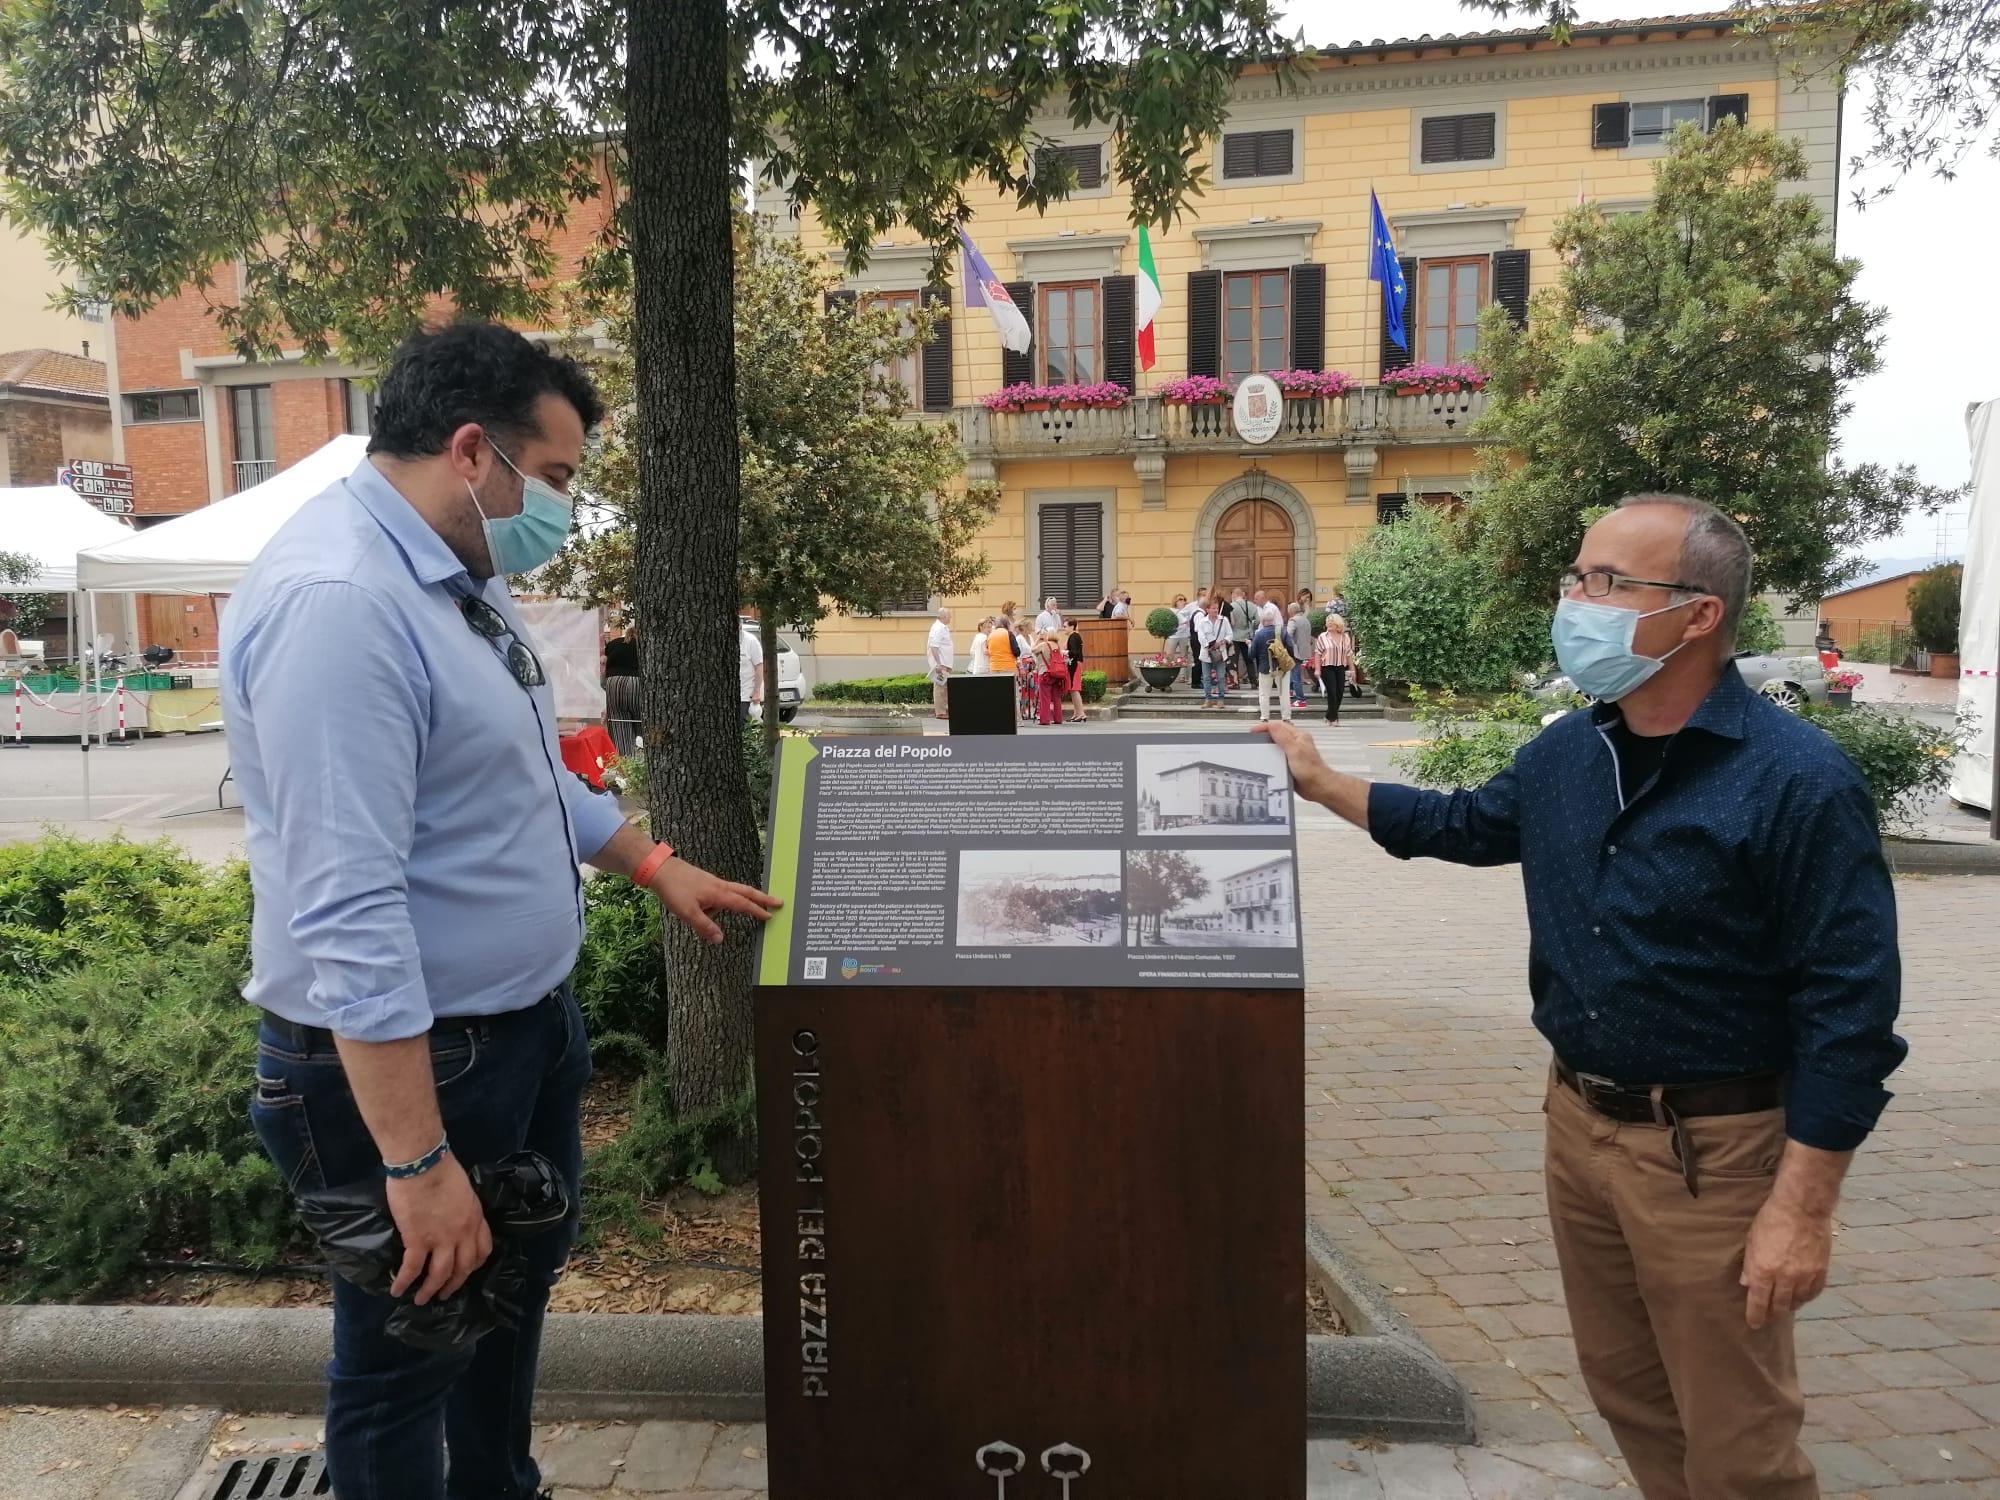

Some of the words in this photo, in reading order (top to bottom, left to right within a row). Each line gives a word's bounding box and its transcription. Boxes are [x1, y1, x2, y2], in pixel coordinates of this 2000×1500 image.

[822, 745, 871, 758] Piazza
[874, 745, 897, 758] del
[900, 744, 952, 760] Popolo
[792, 1029, 824, 1183] POPOLO
[798, 1194, 826, 1260] DEL
[800, 1273, 828, 1398] PIAZZA
